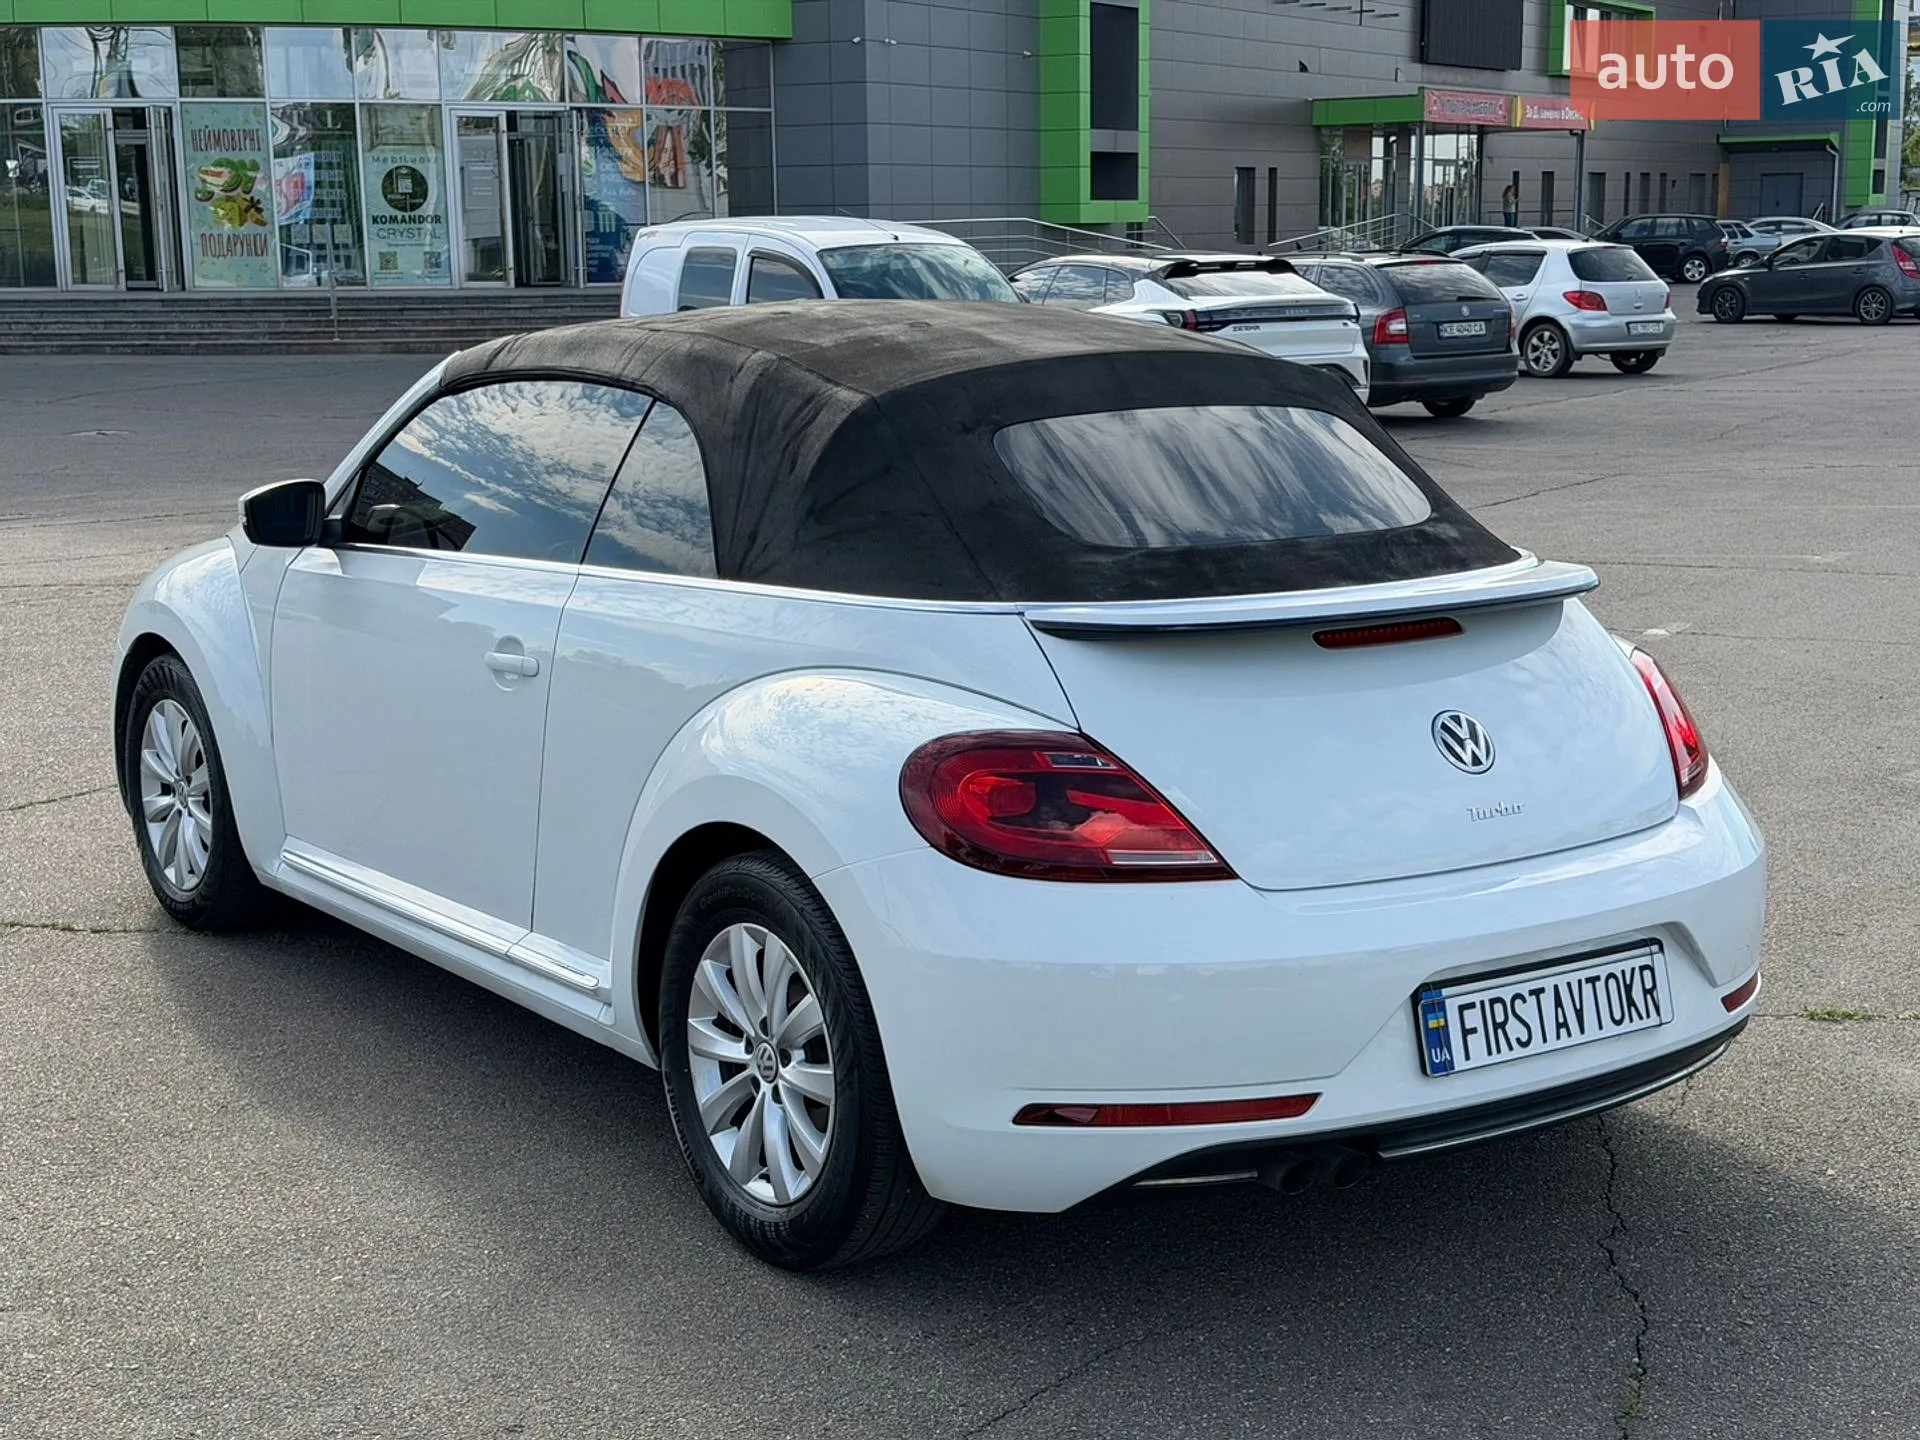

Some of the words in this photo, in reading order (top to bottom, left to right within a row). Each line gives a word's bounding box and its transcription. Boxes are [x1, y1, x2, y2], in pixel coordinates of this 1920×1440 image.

[190, 125, 262, 152] НЕЙМОВІРНІ
[371, 214, 442, 225] KOMANDOR
[376, 227, 440, 240] CRYSTAL
[200, 232, 268, 259] ПОДАРУНКИ
[1466, 802, 1525, 821] Turbo
[1457, 964, 1661, 1062] FIRSTAVTOKR
[1431, 1048, 1451, 1064] UA
